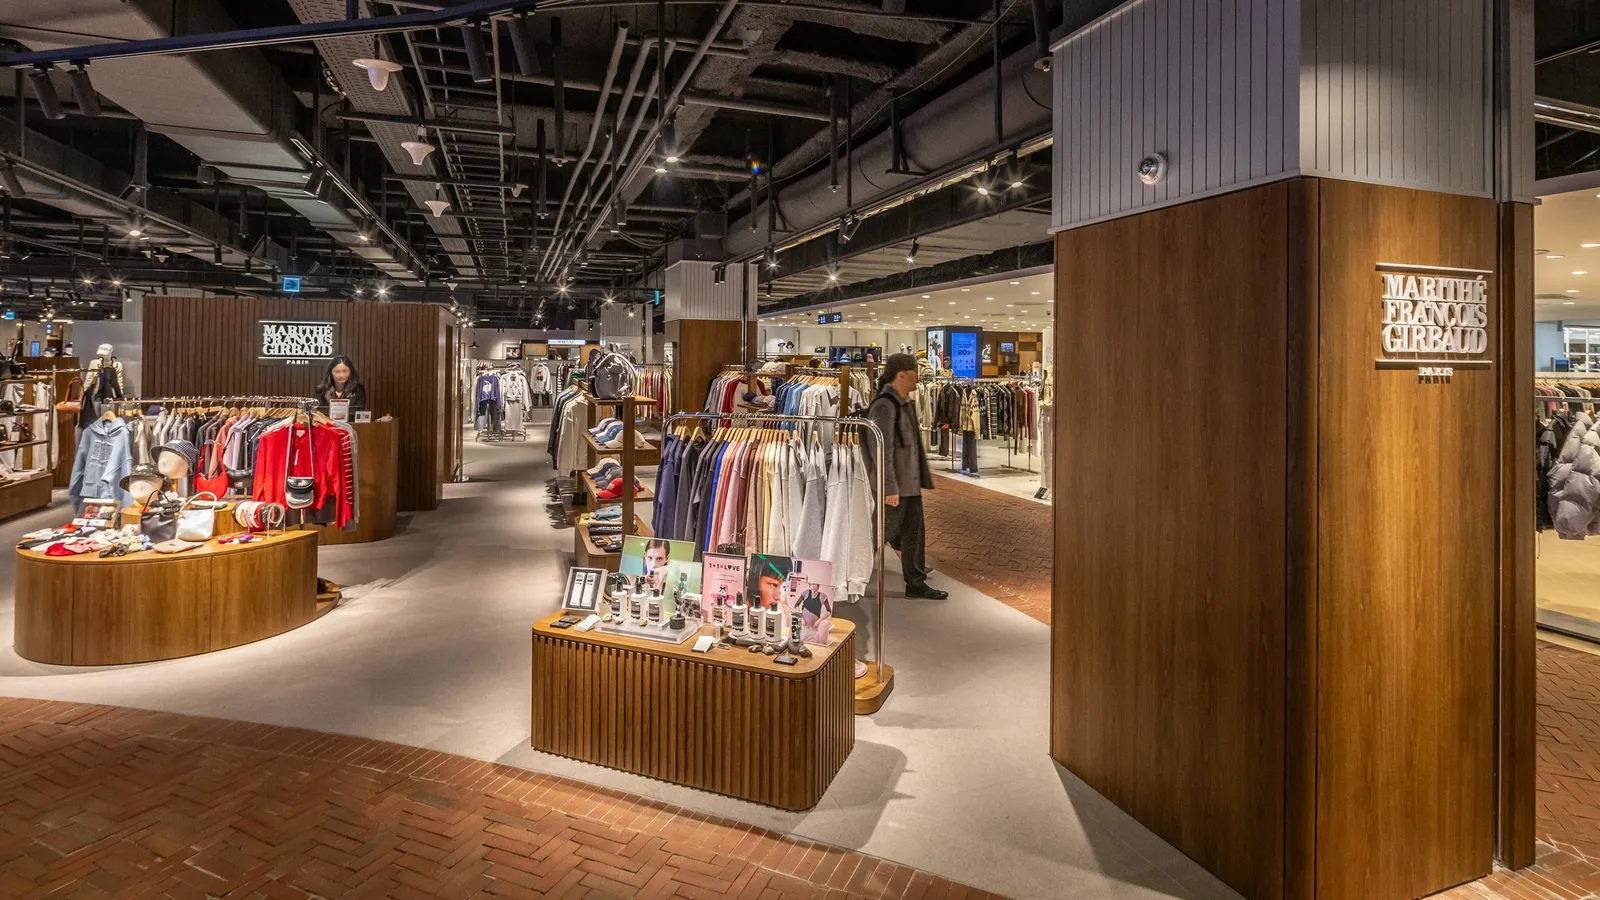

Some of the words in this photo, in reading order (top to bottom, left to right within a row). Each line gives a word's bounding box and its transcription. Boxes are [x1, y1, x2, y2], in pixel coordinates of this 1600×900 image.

[1381, 273, 1488, 304] MARITHÉ
[1382, 325, 1488, 354] GIRBAUD
[262, 344, 333, 356] GIRBAUD
[1417, 367, 1453, 376] PARIS
